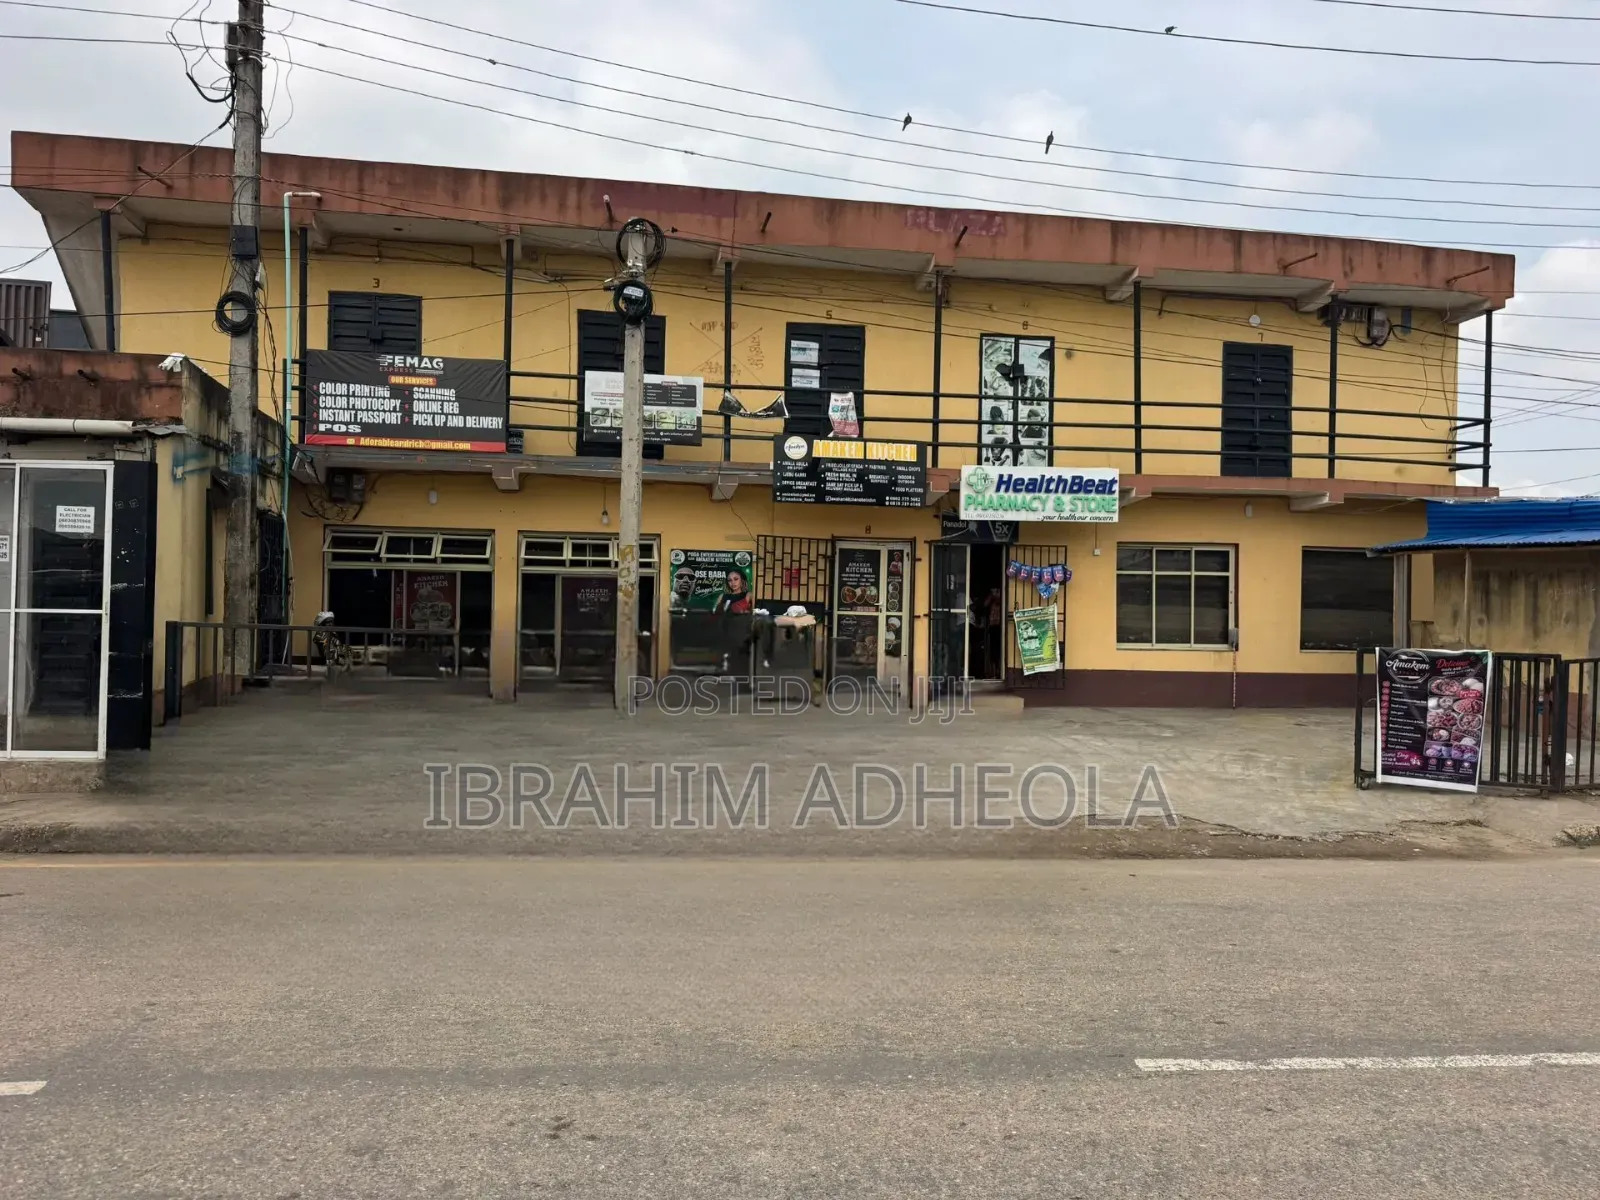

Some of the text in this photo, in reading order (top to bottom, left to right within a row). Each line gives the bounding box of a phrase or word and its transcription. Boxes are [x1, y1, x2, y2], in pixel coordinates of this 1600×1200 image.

[372, 277, 380, 288] 3
[826, 310, 833, 319] 5
[1022, 320, 1029, 330] 6
[1257, 332, 1264, 342] 7
[383, 354, 444, 370] FEMAG
[404, 377, 433, 385] SERVICES
[319, 382, 391, 397] COLOR PRINTING
[413, 387, 456, 401] SCANNING
[319, 396, 401, 411] COLOR PHOTOCOPY
[413, 400, 459, 414] ONLINE REG
[319, 409, 402, 424] INSTANT PASSPORT
[413, 413, 503, 429] PICK UP AND DELIVERY
[318, 423, 362, 433] POS
[360, 437, 471, 450] Adorableandrich@gmail.com
[812, 440, 917, 461] AMAKEM KITCHEN
[995, 473, 1118, 495] HealthBeat
[964, 495, 1117, 513] PHARMACY & STORE
[708, 571, 727, 579] BABA
[414, 581, 448, 589] KITCHEN
[1385, 659, 1430, 671] Amakem
